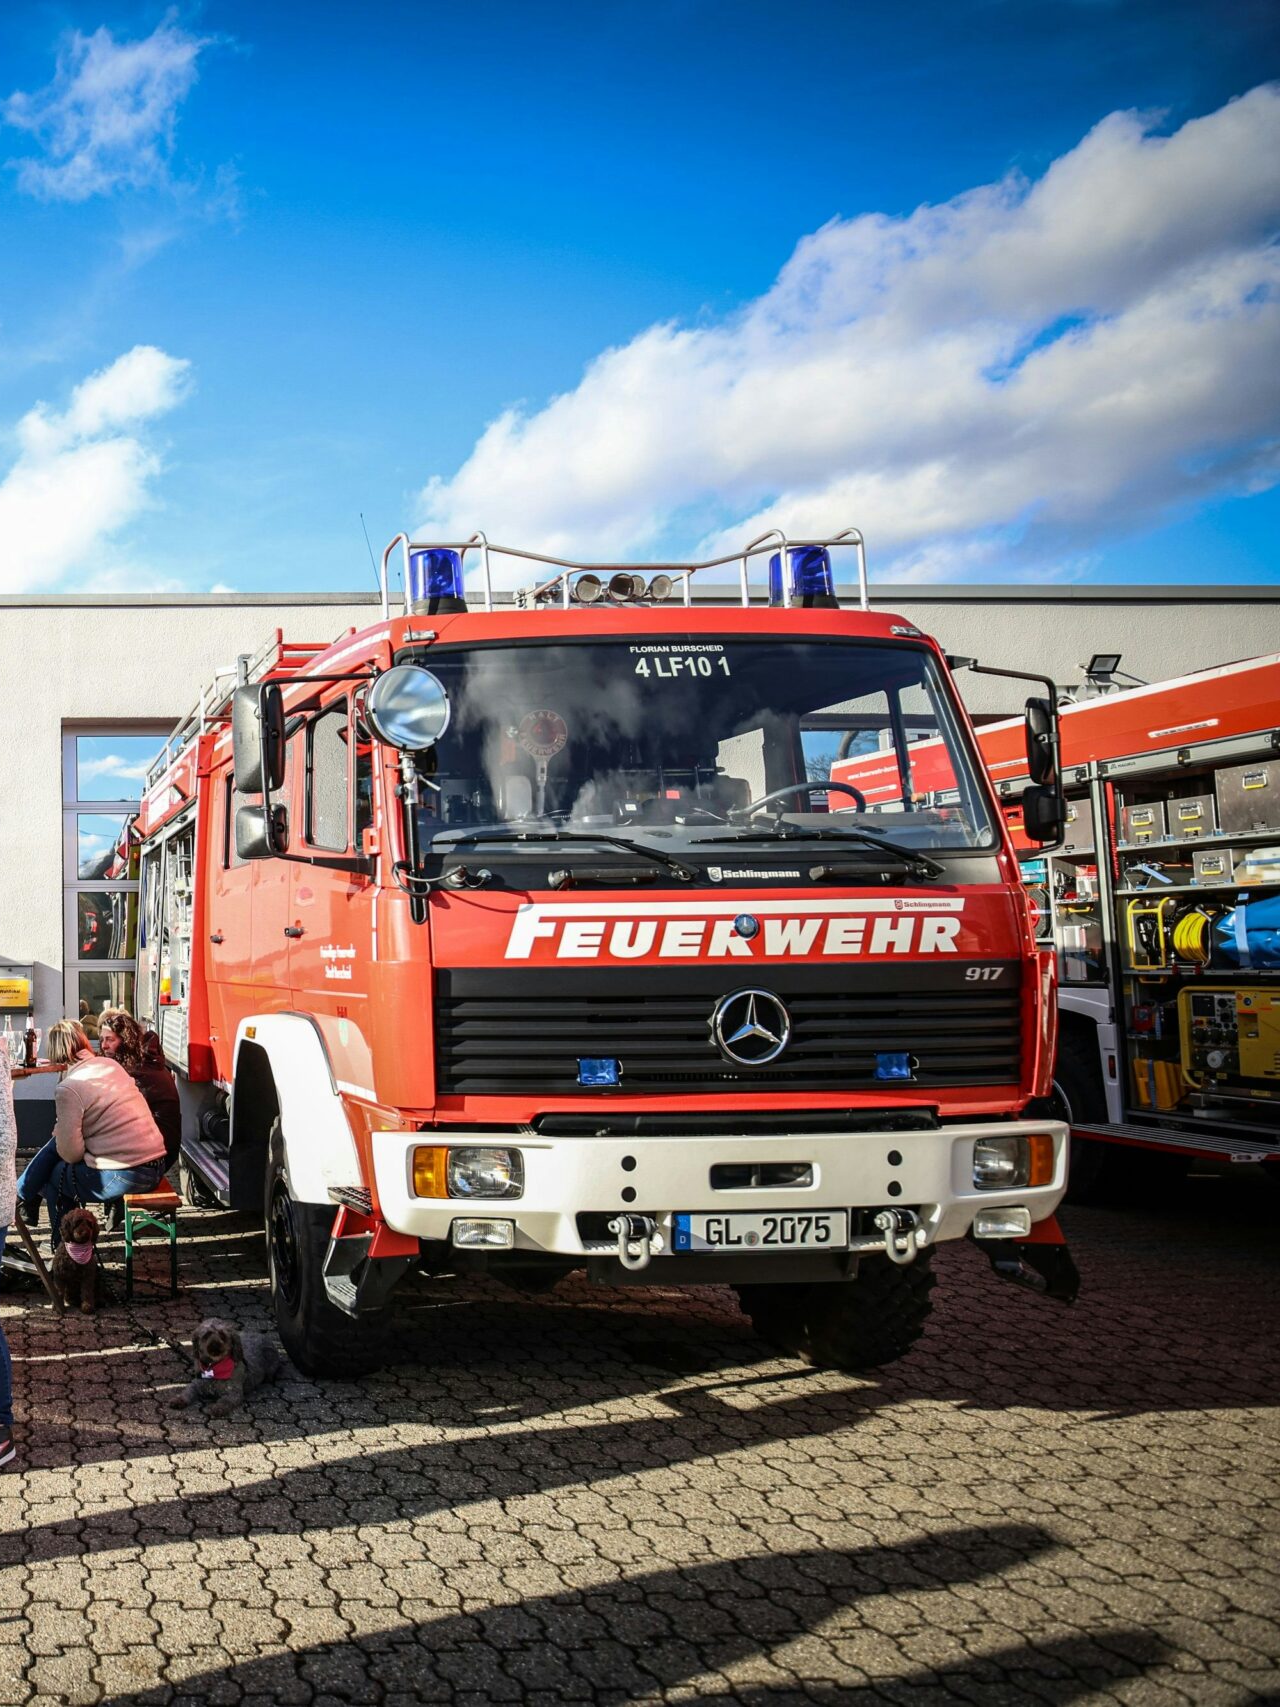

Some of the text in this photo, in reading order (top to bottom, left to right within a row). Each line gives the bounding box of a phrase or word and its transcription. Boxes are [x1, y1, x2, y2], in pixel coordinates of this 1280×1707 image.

[635, 656, 731, 677] 4 LF10 1
[722, 870, 801, 879] Schlingmann
[504, 904, 961, 960] FEUERWEHR
[964, 967, 1005, 981] 917
[679, 1216, 831, 1245] D GL 2075
